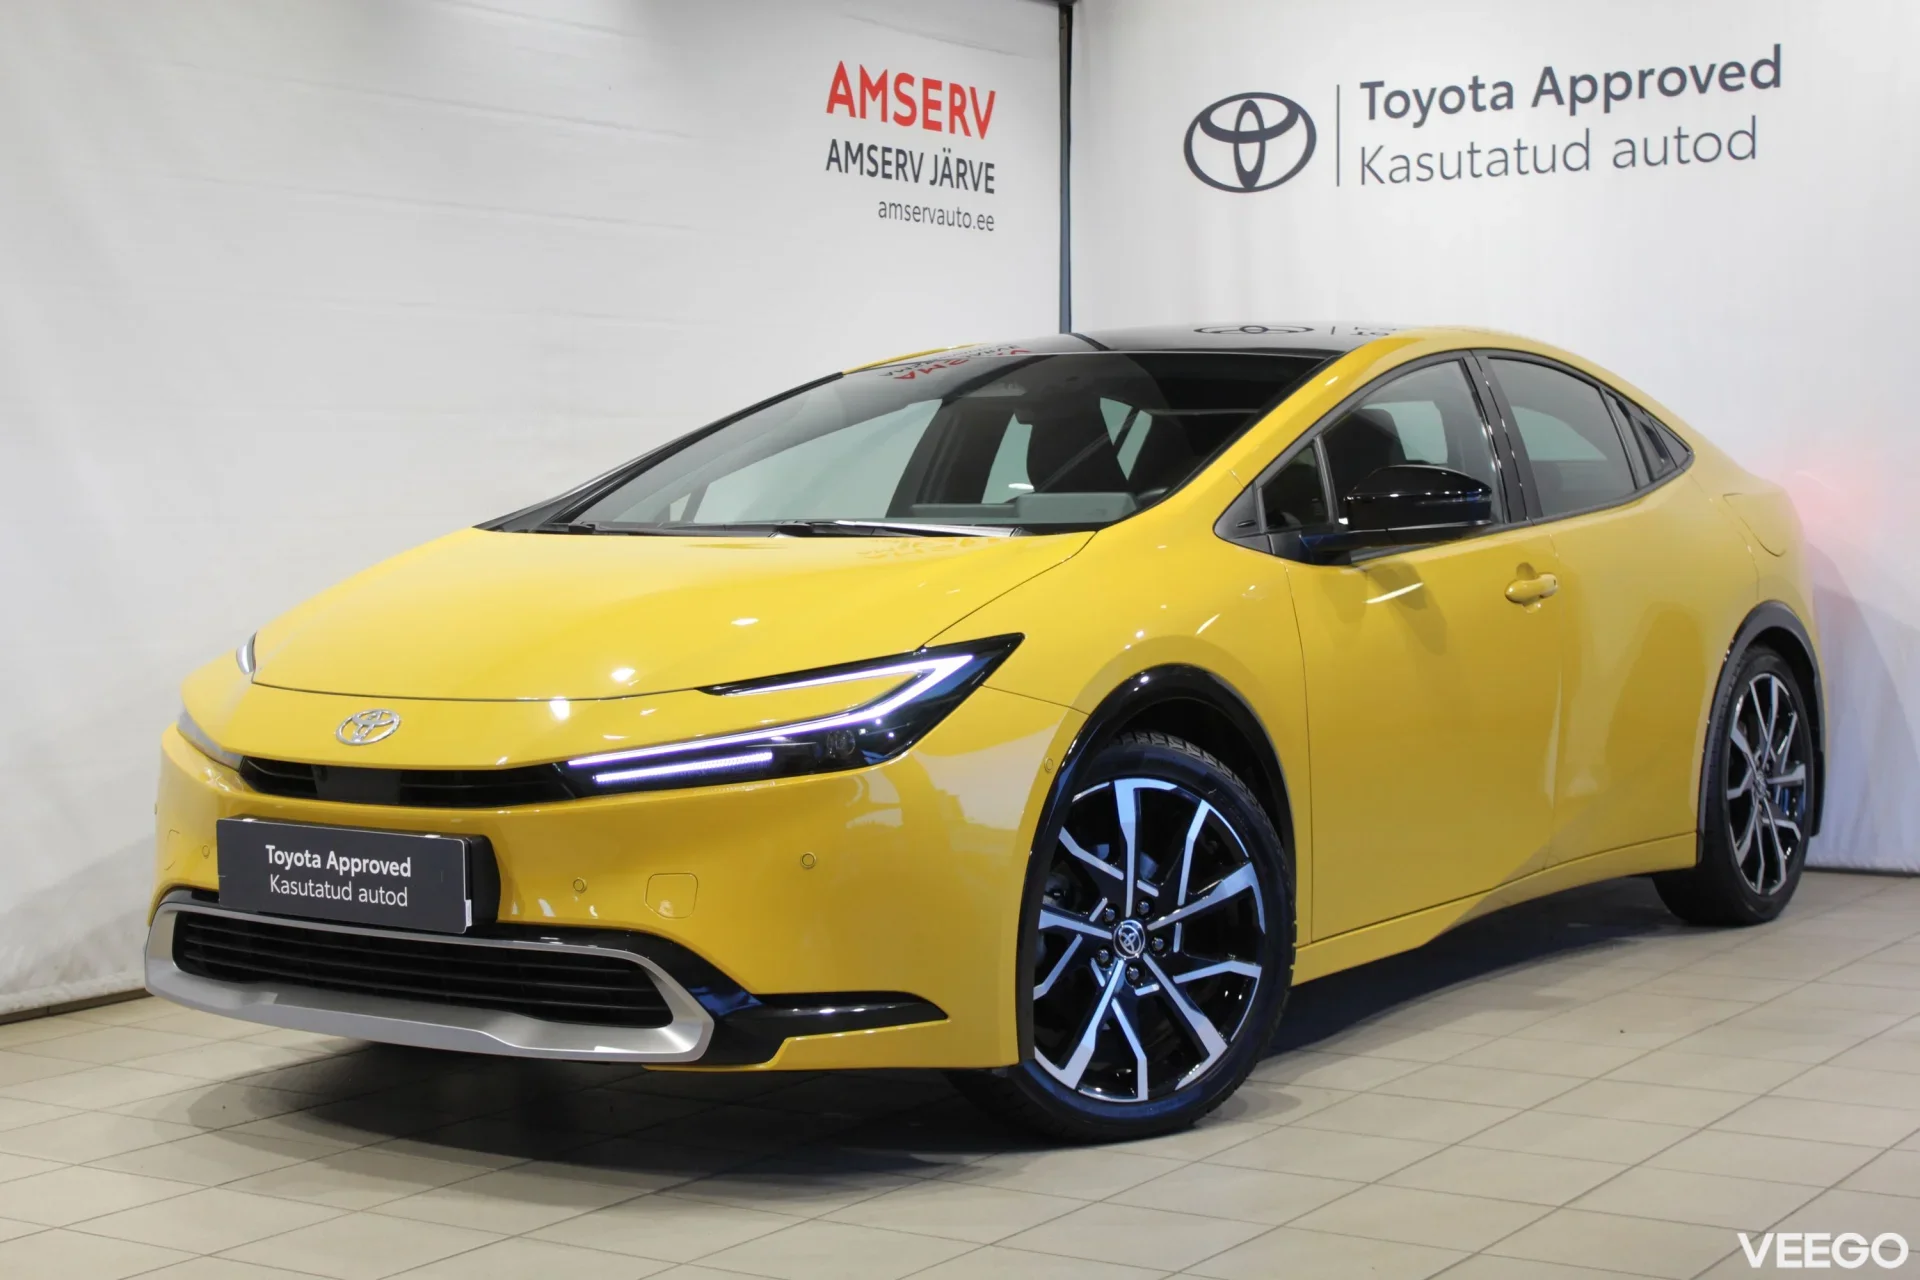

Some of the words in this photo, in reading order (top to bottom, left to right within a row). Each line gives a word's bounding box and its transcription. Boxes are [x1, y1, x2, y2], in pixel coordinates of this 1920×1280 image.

[826, 60, 996, 140] AMSERV
[1359, 75, 1514, 129] Toyota
[1531, 43, 1782, 116] Approved
[825, 138, 924, 184] AMSERV
[929, 147, 995, 195] JÄRVE
[1360, 127, 1590, 186] Kasutatud
[1612, 115, 1757, 169] autod
[878, 200, 995, 232] amservauto.ee
[265, 844, 322, 871] Toyota
[326, 850, 412, 878] Approved
[270, 873, 353, 901] Kasutatud
[358, 886, 408, 907] autod
